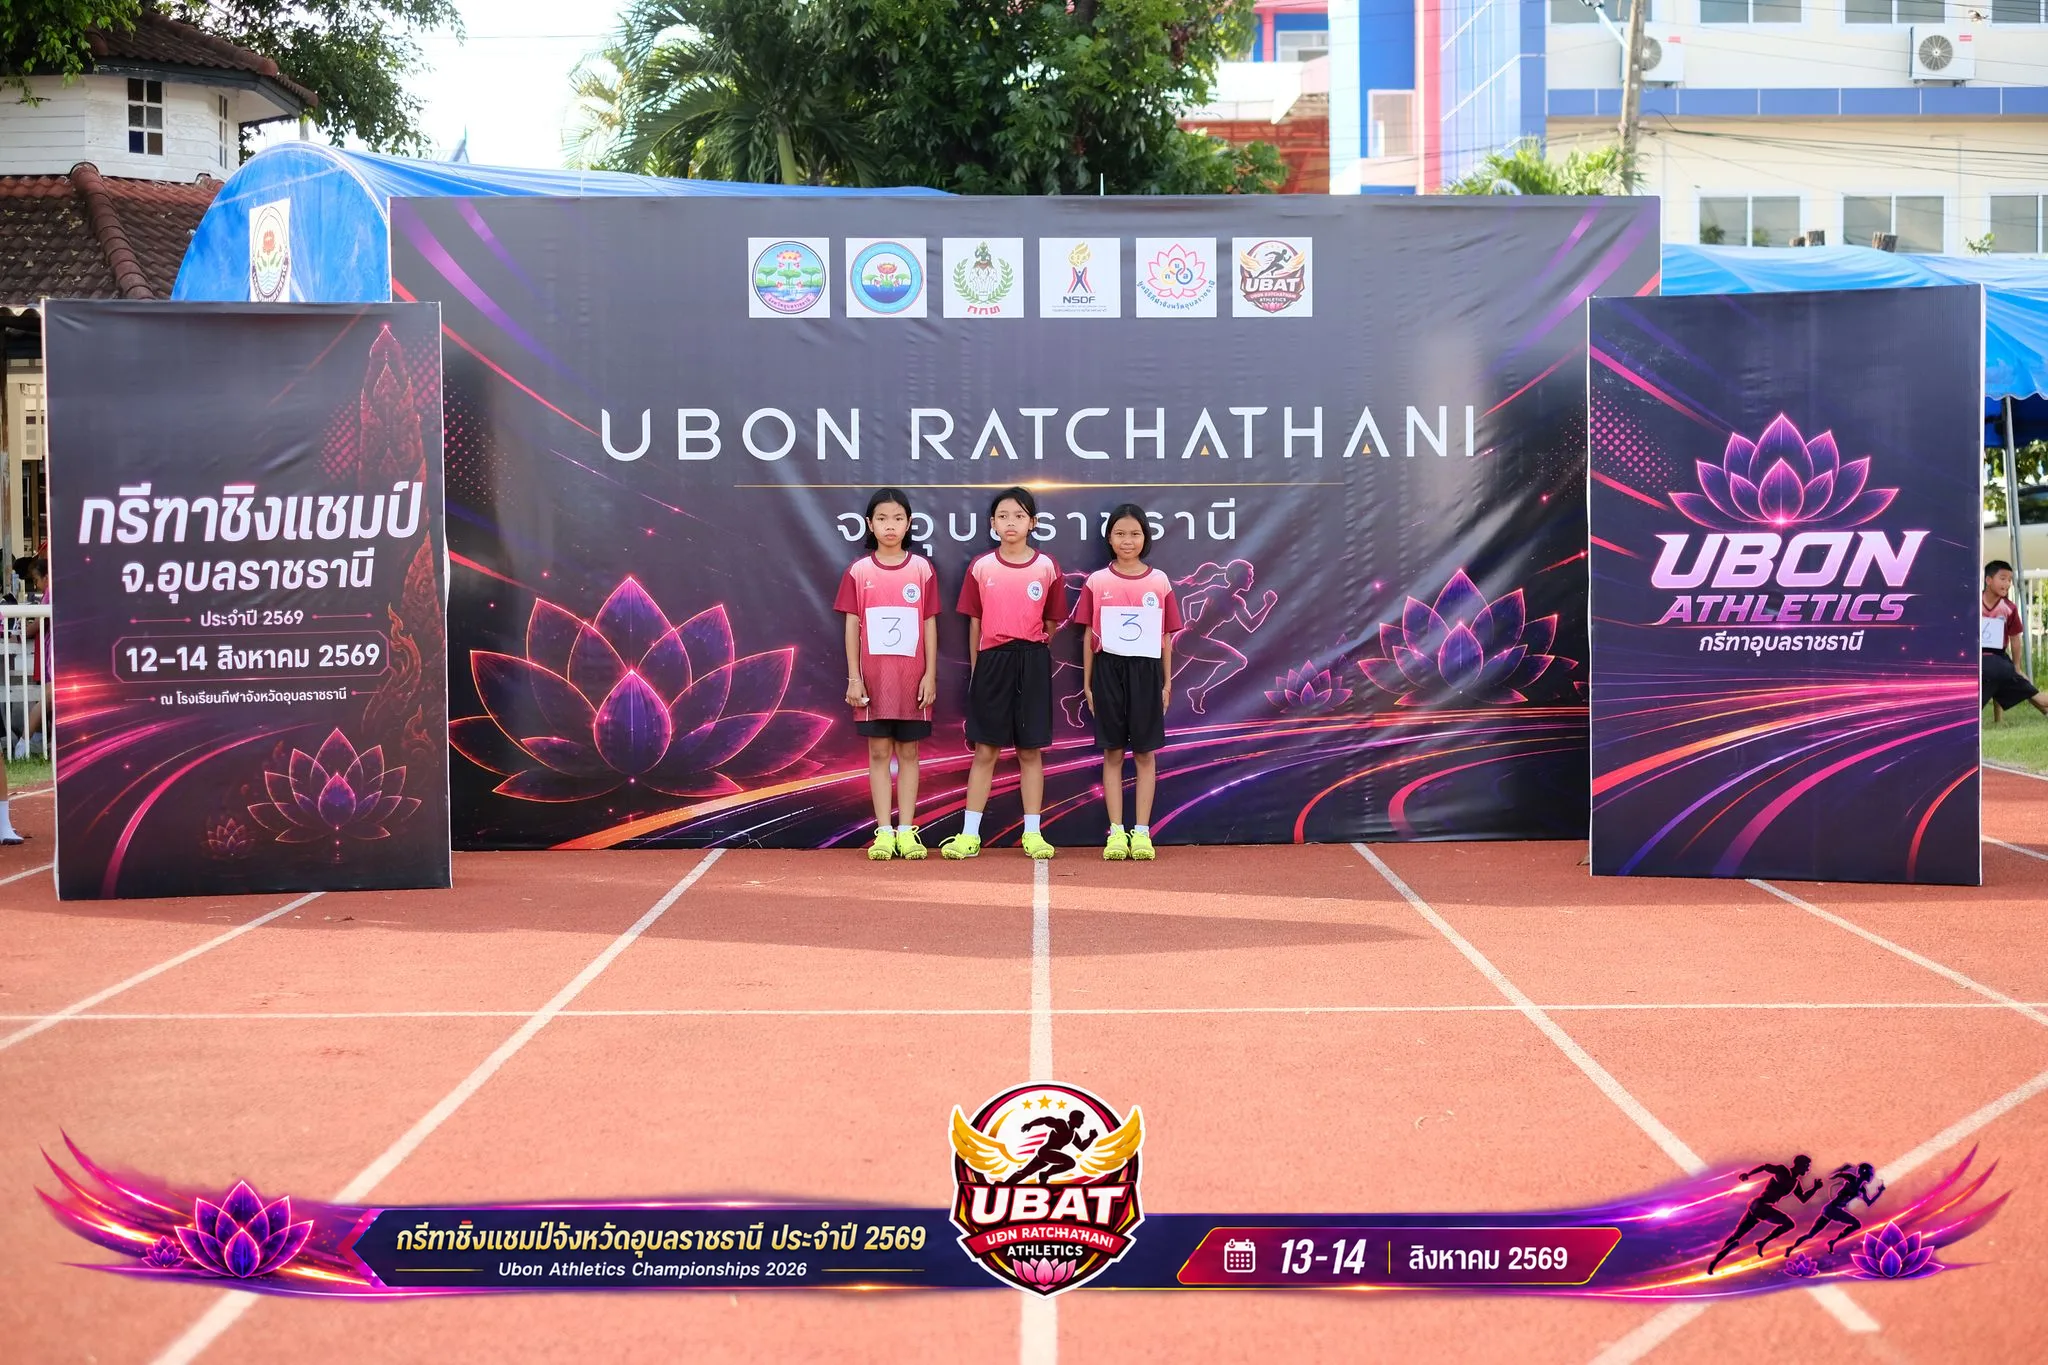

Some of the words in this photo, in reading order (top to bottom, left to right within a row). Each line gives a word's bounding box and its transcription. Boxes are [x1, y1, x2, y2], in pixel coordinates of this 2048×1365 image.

[1245, 278, 1301, 292] UBAT
[1062, 296, 1096, 304] NSDF
[601, 408, 860, 462] UBON
[911, 405, 1475, 460] RATCHATHANI
[1650, 530, 1931, 590] UBON
[121, 547, 375, 604] จ.อุบลราชธานี
[200, 609, 258, 627] ประจำปี
[263, 610, 304, 626] 2569
[1651, 594, 1918, 625] ATHLETICS
[881, 616, 902, 648] 3
[1119, 613, 1143, 642] 3
[217, 645, 310, 671] สิงหาคม
[318, 643, 381, 668] 2569
[160, 694, 173, 706] ณ
[176, 686, 348, 705] โรงเรียนกีฬาจังหวัดอุบลราชธานี
